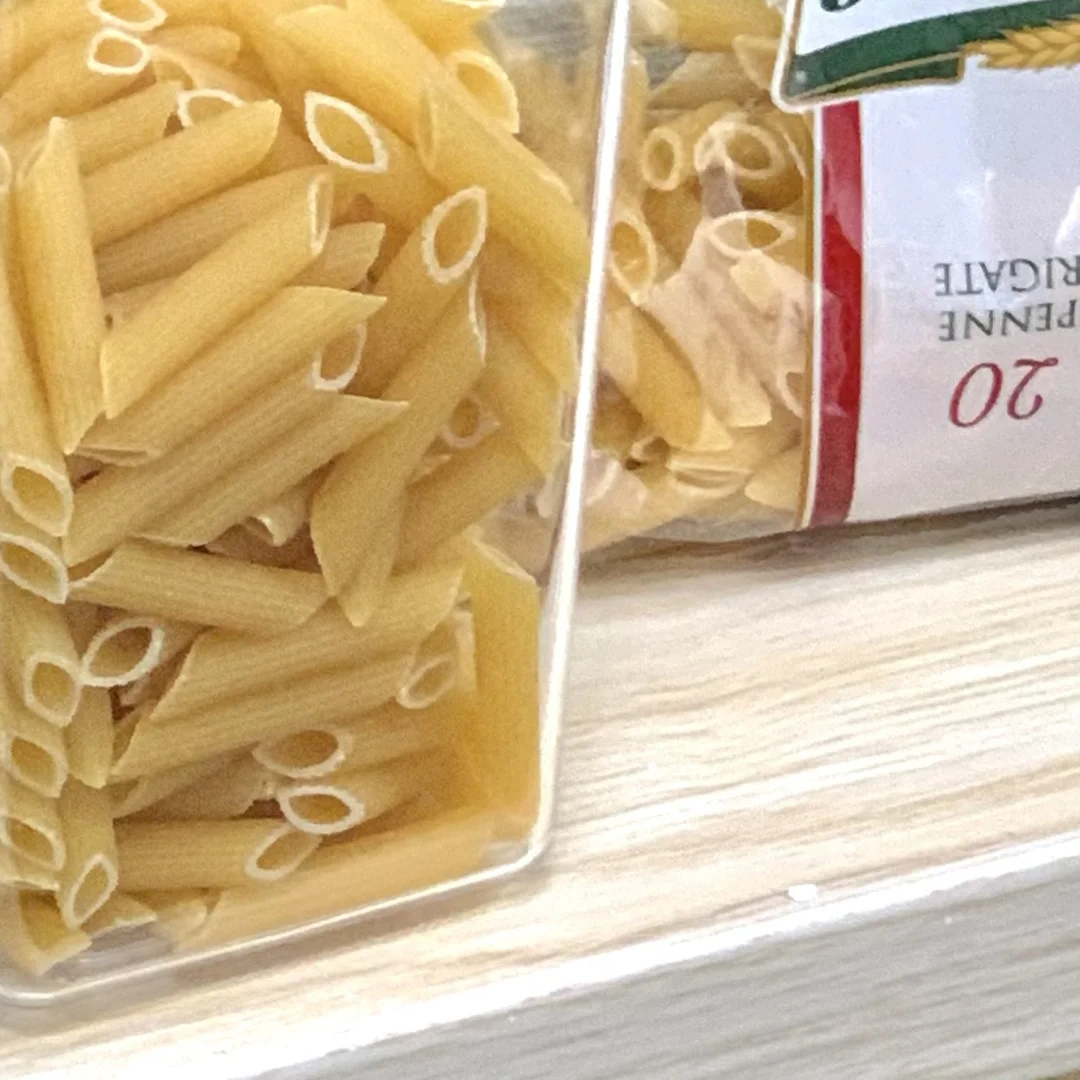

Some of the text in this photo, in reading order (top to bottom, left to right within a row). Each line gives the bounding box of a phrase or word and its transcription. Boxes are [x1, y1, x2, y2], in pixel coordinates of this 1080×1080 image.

[933, 255, 1080, 296] RIGATE
[938, 299, 1077, 342] PENNE
[948, 357, 1059, 428] 20
